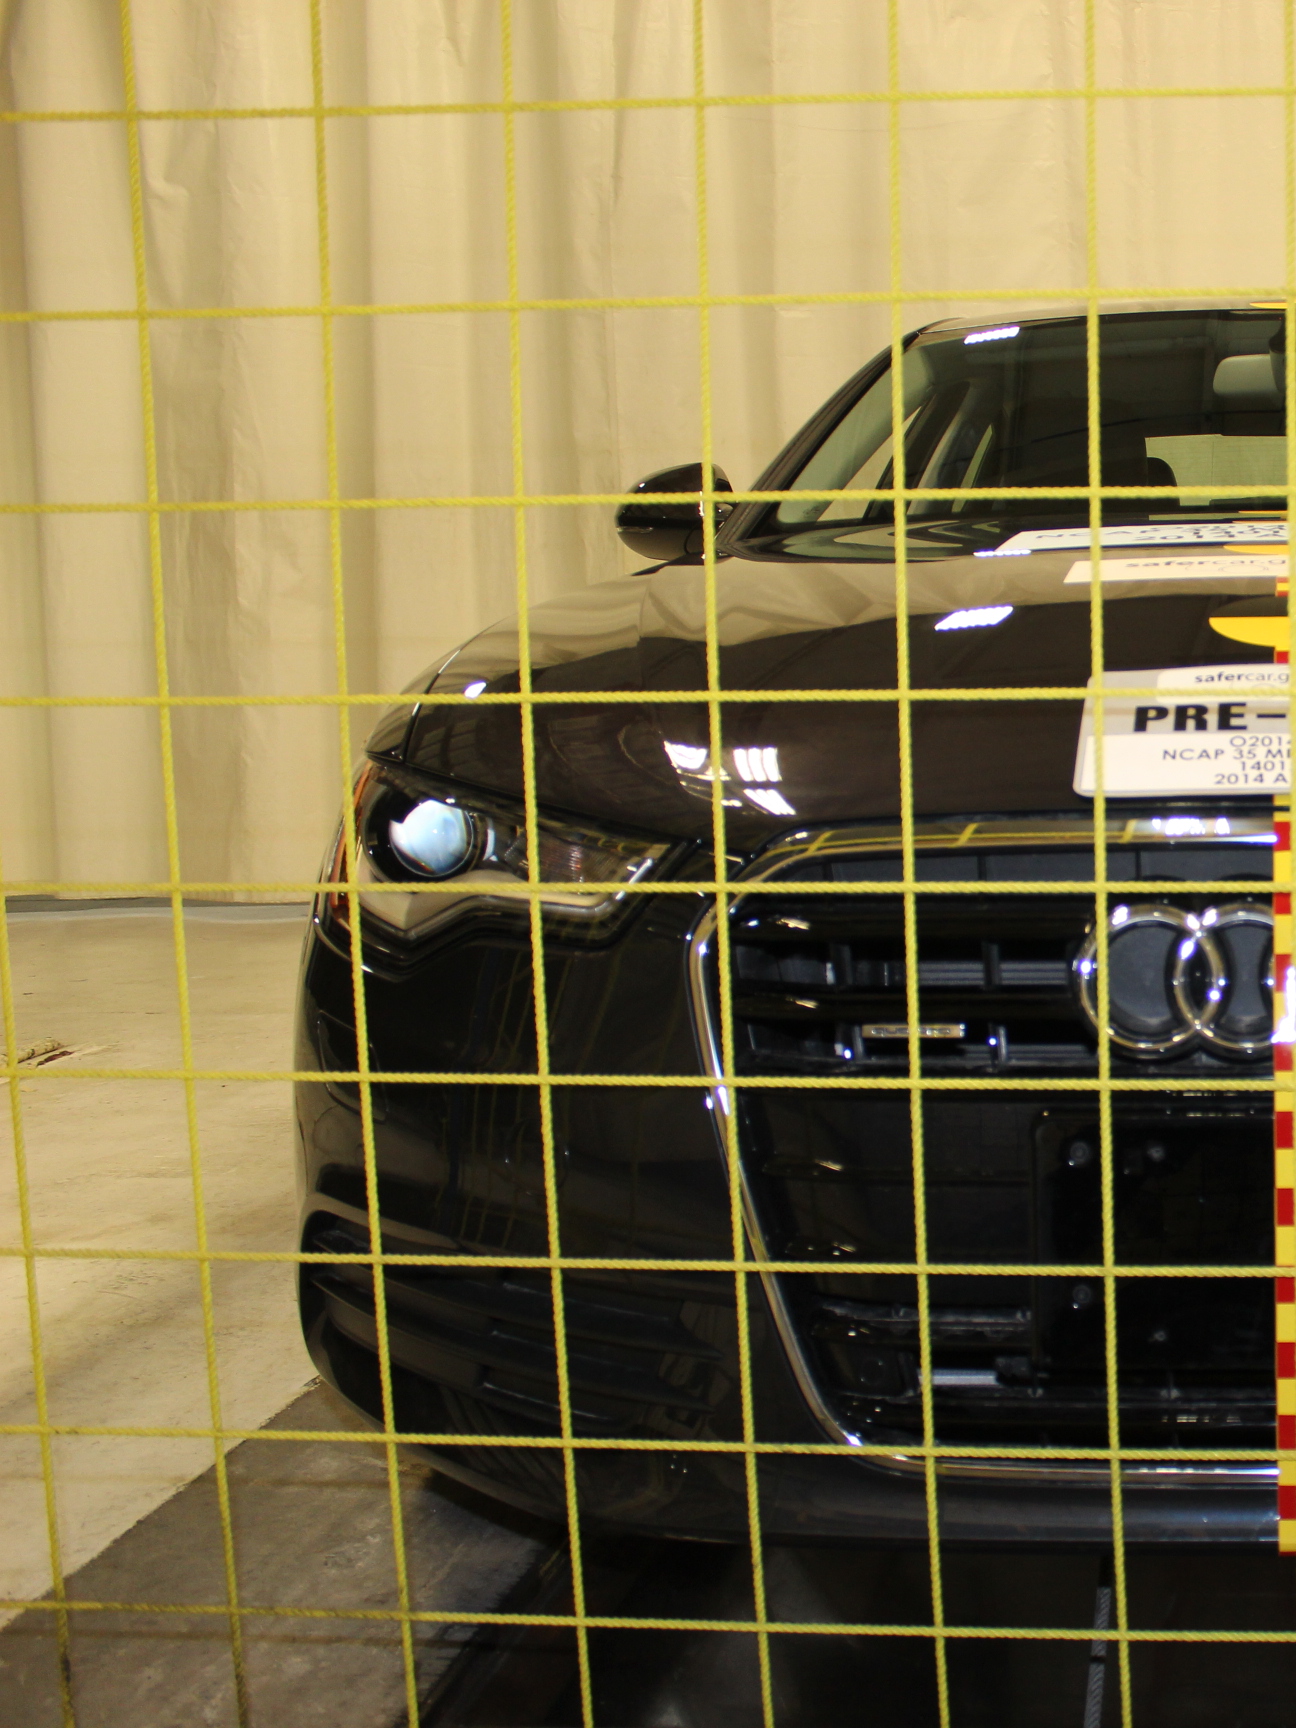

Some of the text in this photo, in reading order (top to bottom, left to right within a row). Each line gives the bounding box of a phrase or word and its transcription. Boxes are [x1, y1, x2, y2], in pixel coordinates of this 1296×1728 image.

[1162, 748, 1225, 760] NCAP
[1233, 748, 1257, 760] 35
[1214, 773, 1265, 785] 2014
